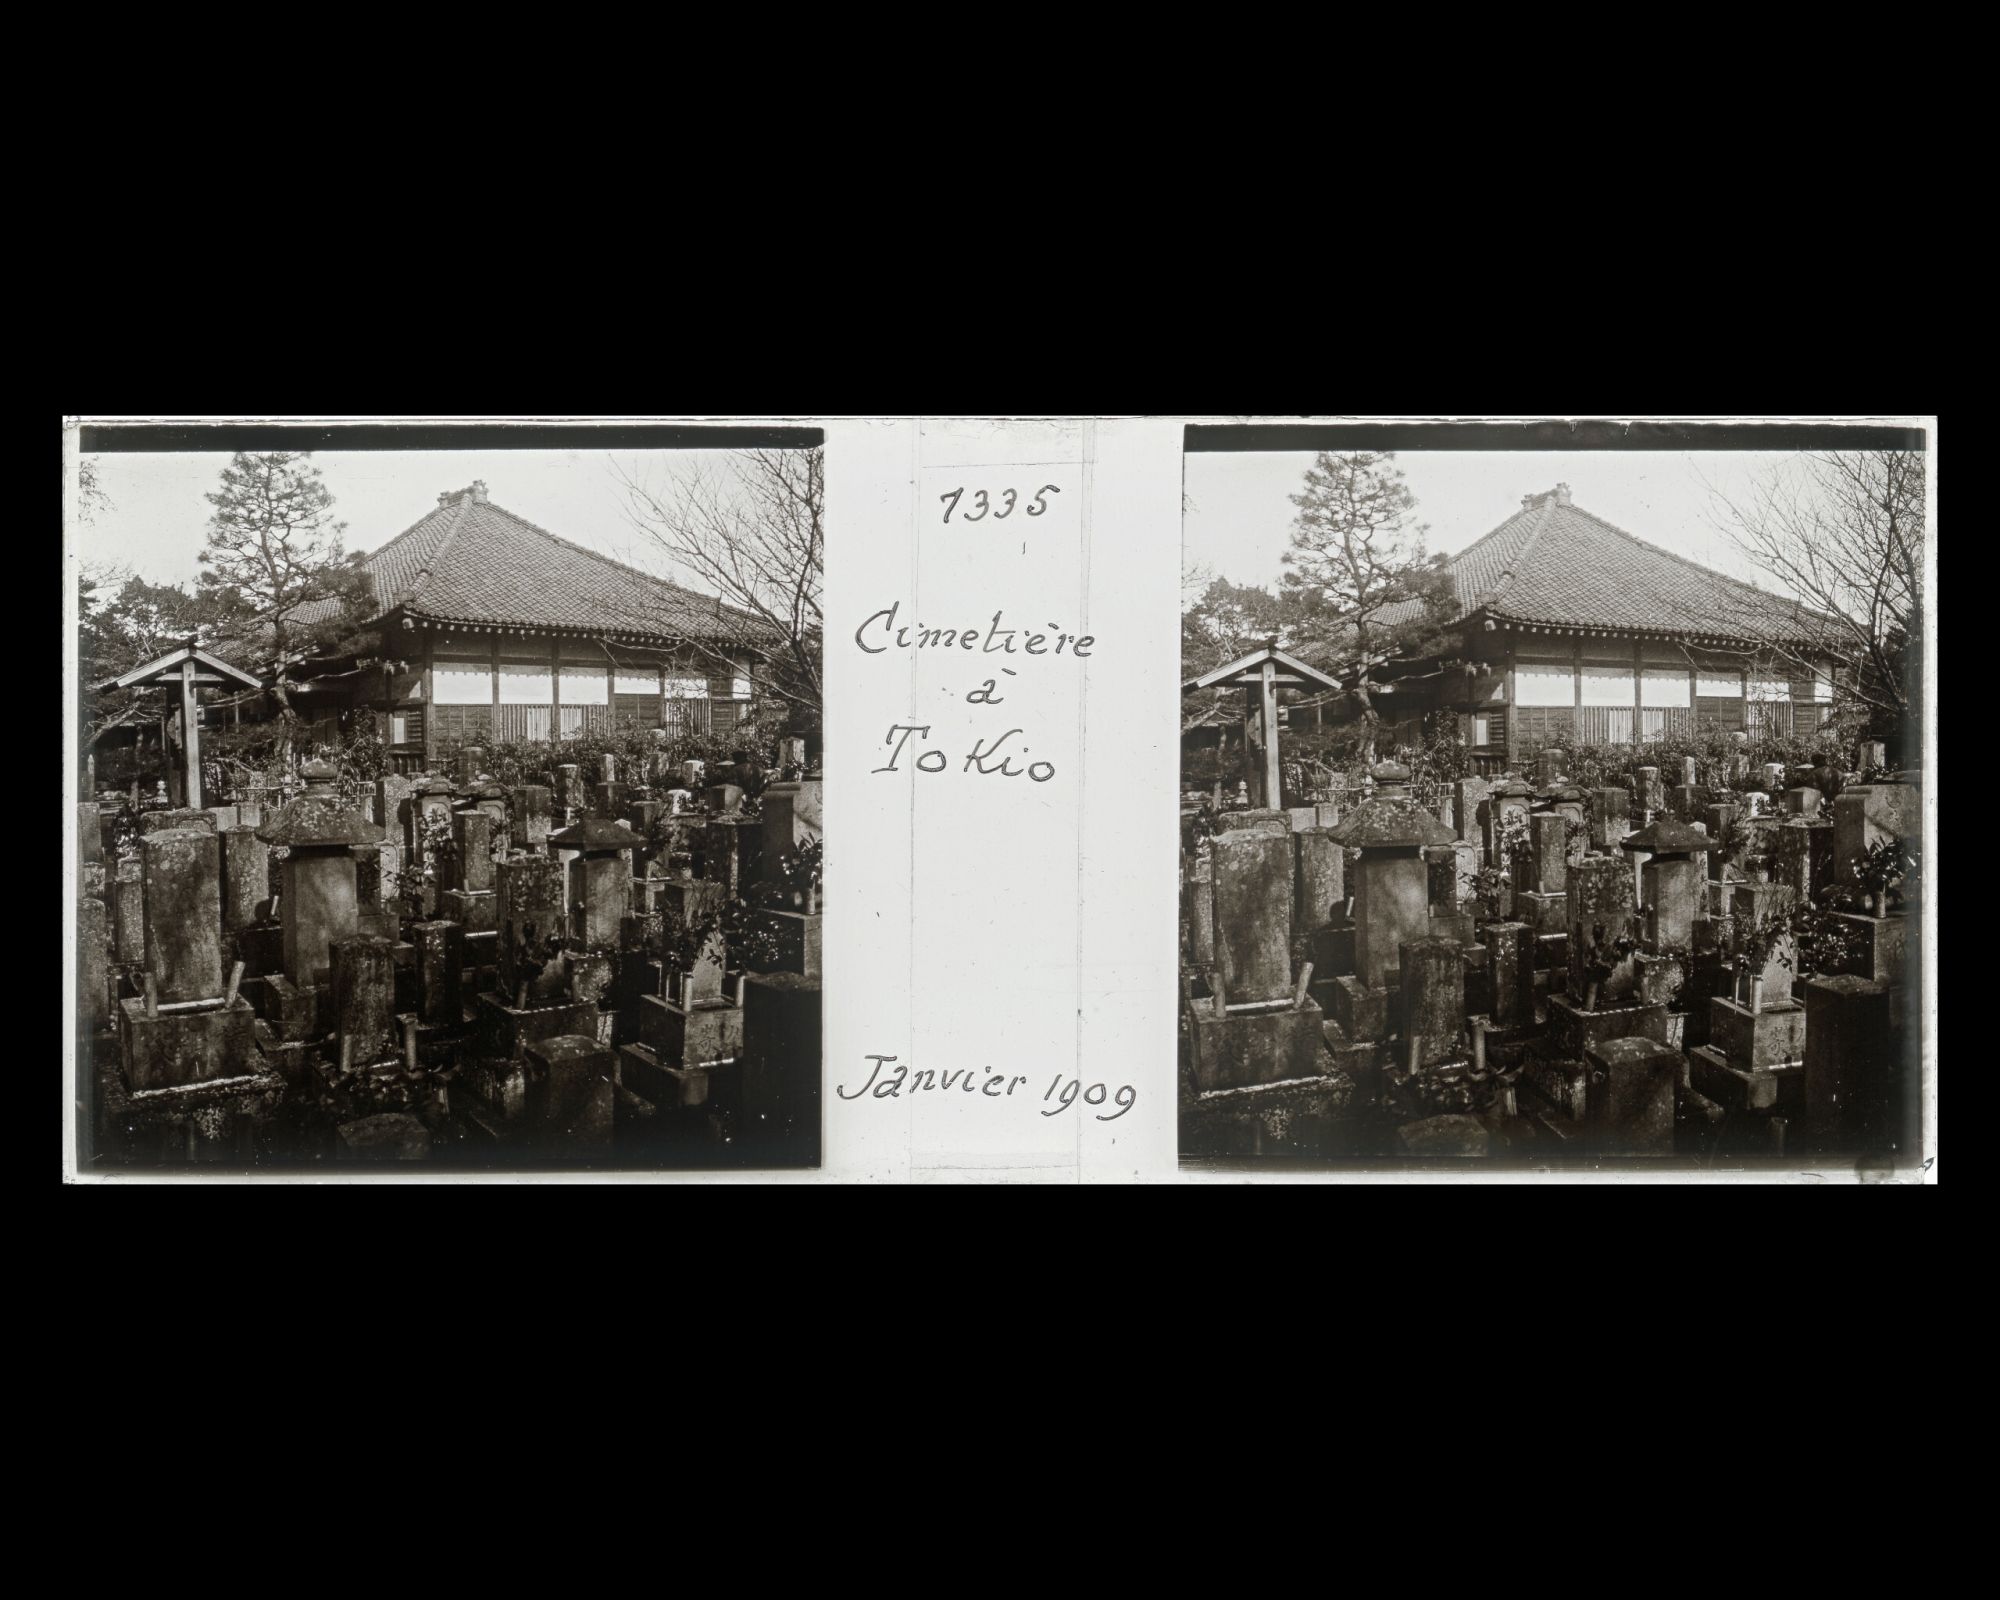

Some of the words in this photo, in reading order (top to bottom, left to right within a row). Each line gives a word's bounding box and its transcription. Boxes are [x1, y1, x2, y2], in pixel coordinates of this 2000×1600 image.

[940, 484, 1061, 524] 7335
[855, 601, 1096, 658] Cimetière
[966, 667, 1017, 705] à
[837, 1055, 1027, 1100] Janvier
[1041, 1074, 1137, 1121] 1909
